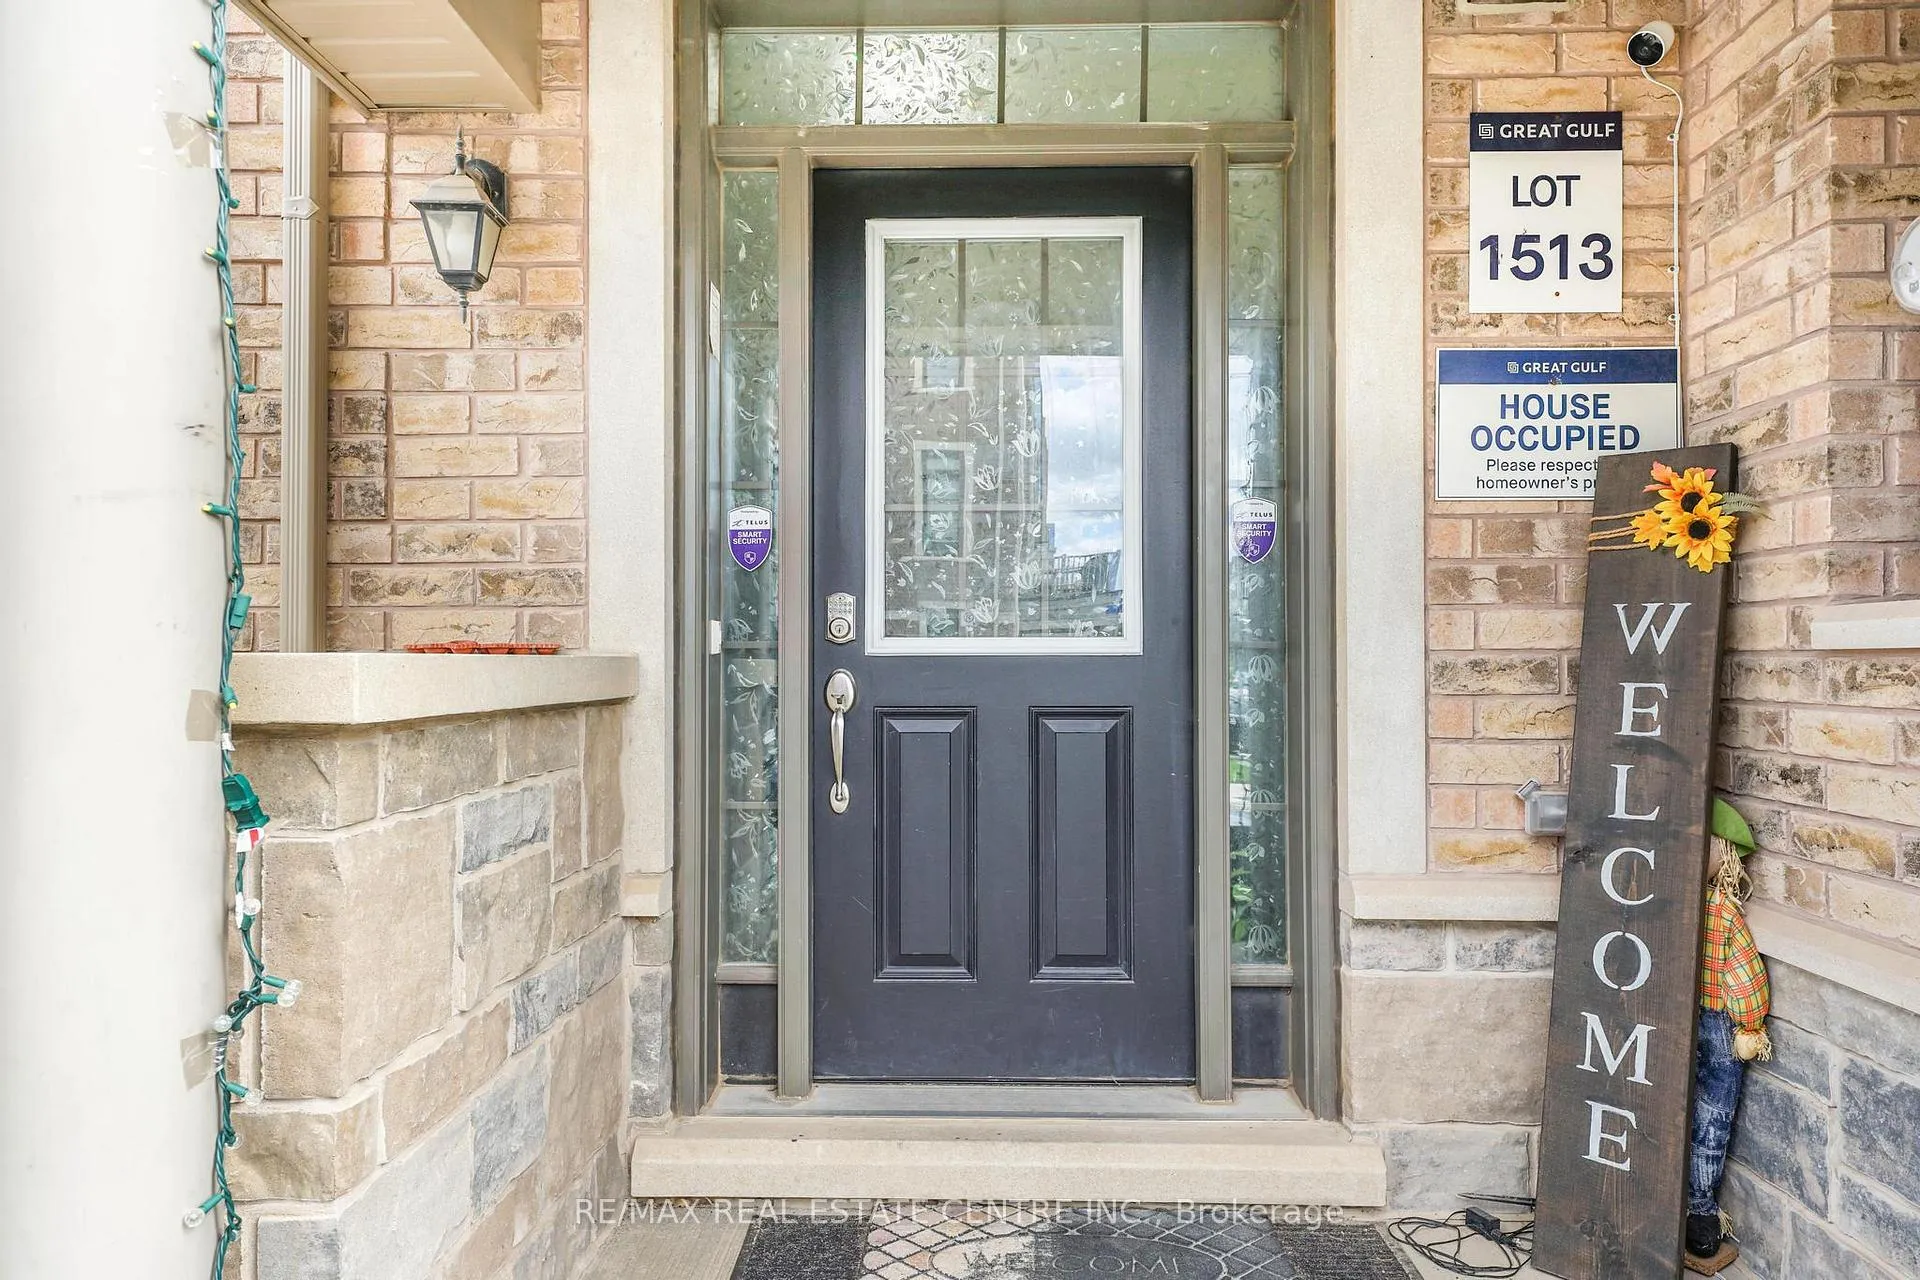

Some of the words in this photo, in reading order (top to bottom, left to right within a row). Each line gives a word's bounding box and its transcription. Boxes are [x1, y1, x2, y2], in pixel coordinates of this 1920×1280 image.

[1500, 123, 1562, 139] GREAT
[1566, 122, 1615, 138] GULF
[1512, 174, 1581, 207] LOT
[1479, 232, 1614, 281] 1513
[1522, 362, 1568, 374] GREAT
[1571, 361, 1607, 373] GULF
[1500, 393, 1611, 420] HOUSE
[1470, 424, 1640, 451] OCCUPIED
[1486, 458, 1536, 472] Please
[1541, 459, 1599, 475] respect
[1476, 476, 1578, 490] homeowner's
[1576, 602, 1692, 1171] WELCOME
